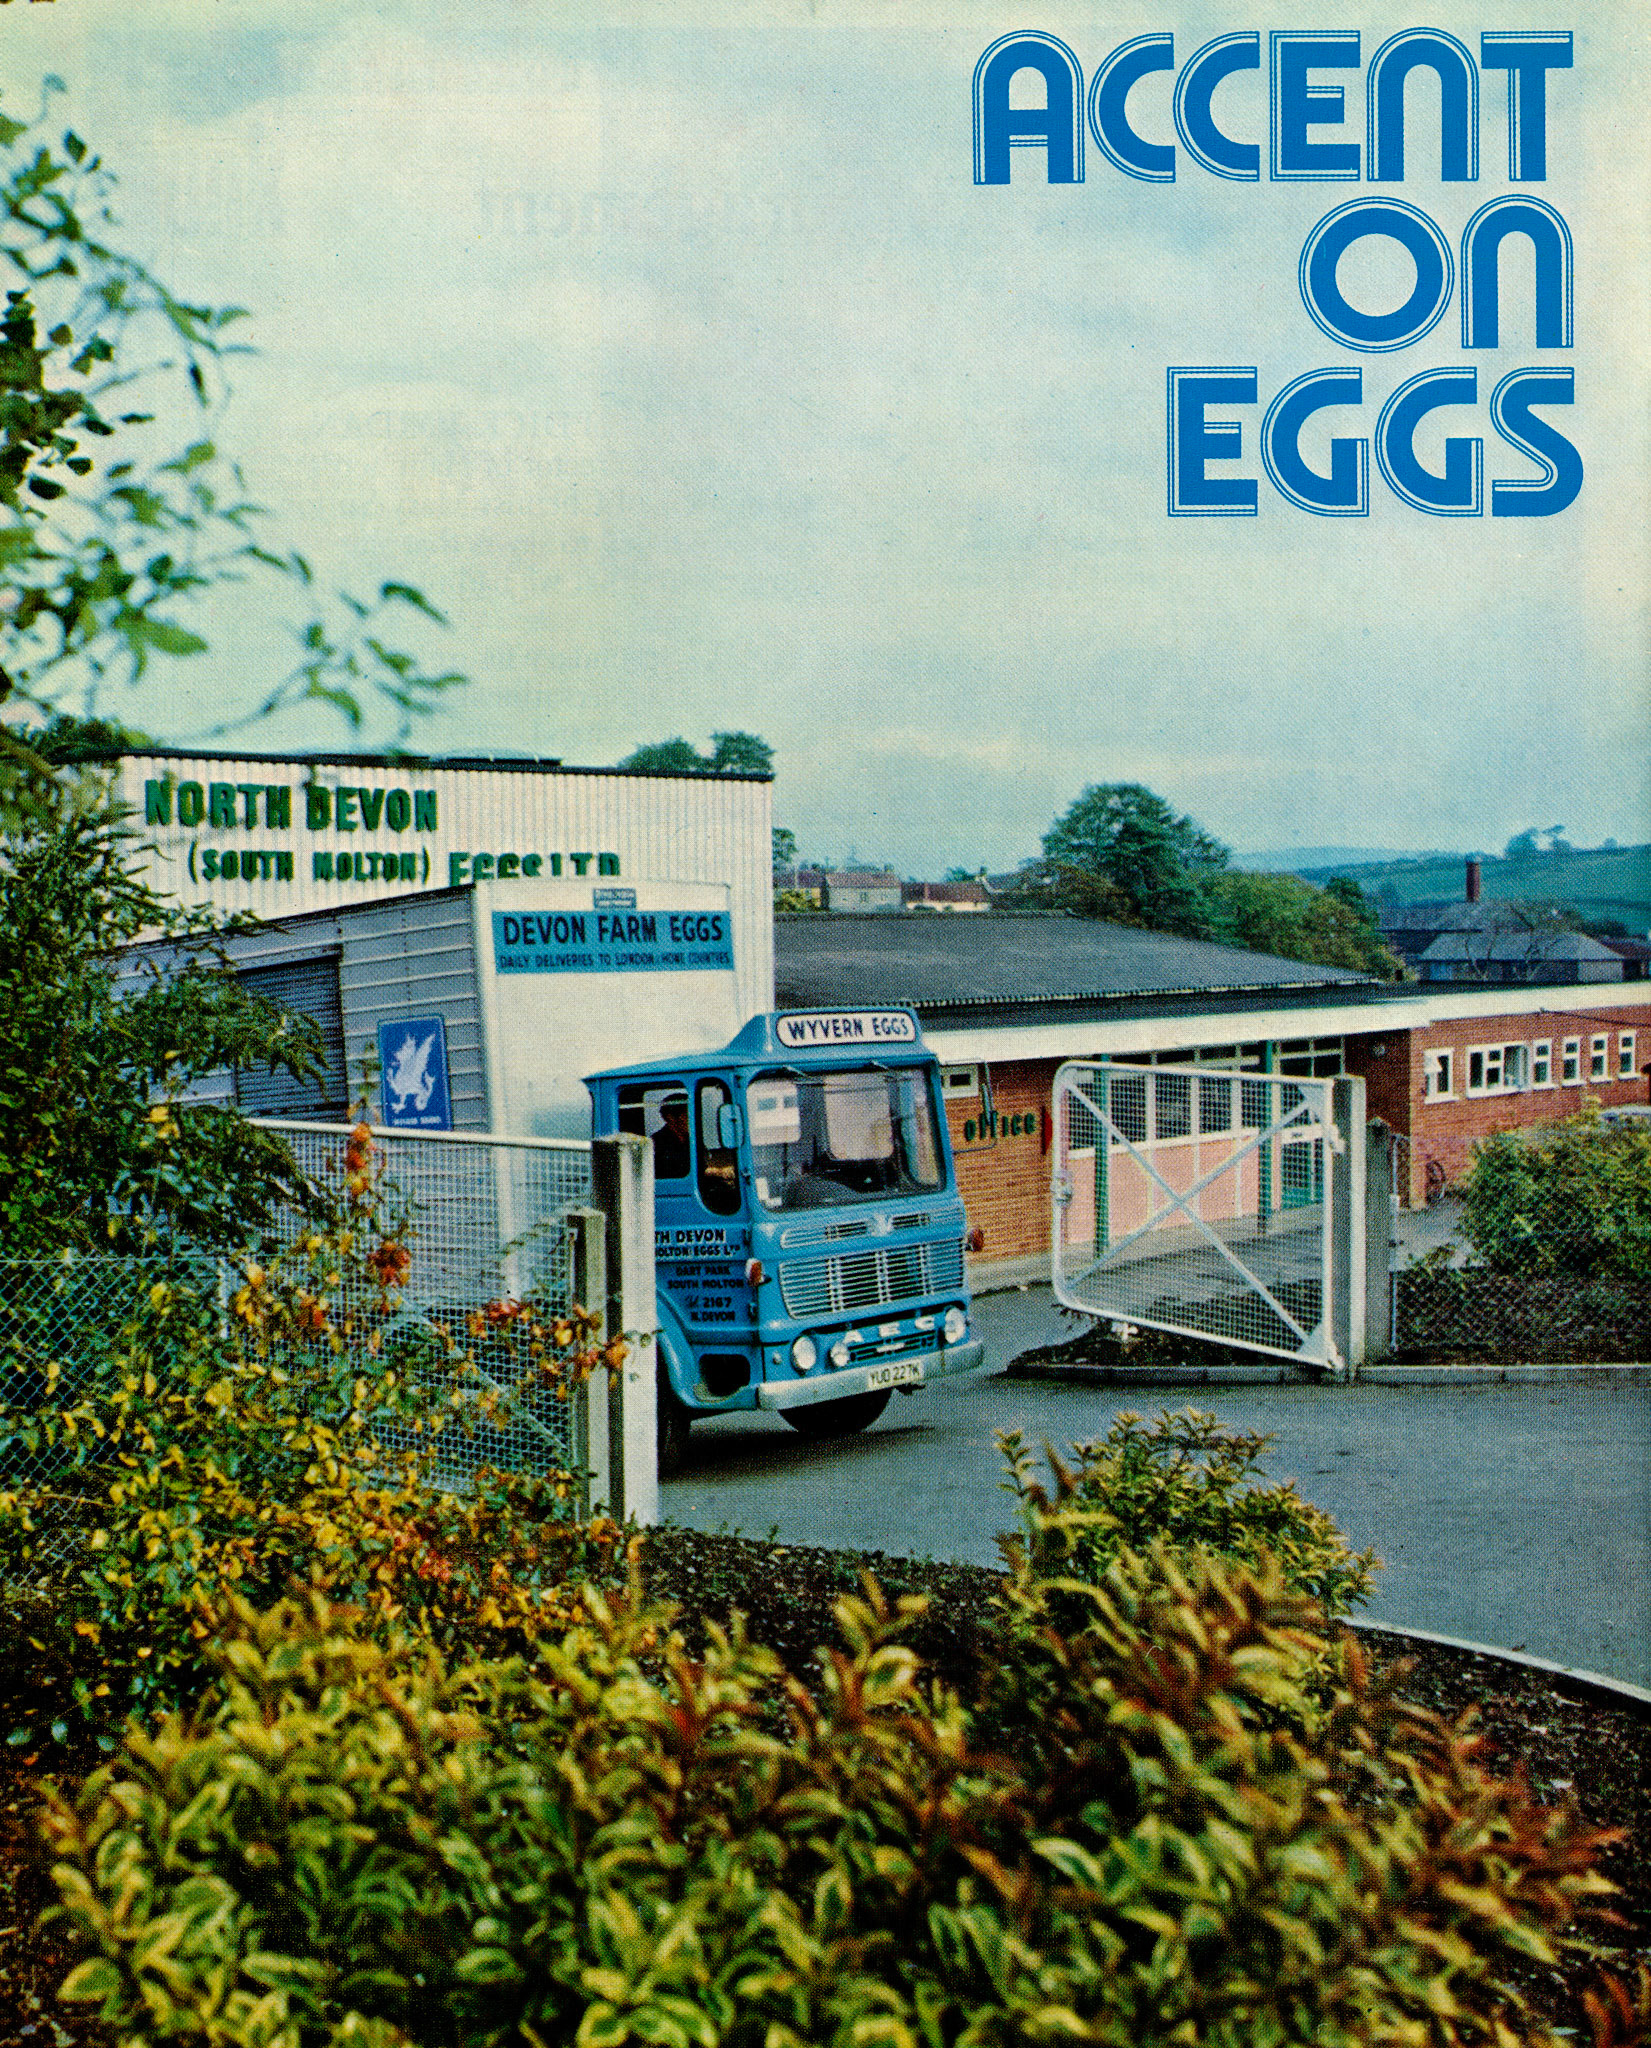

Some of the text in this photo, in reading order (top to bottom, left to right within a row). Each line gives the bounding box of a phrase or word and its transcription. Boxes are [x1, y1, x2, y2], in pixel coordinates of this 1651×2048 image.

[145, 779, 438, 833] NORTH DEVON
[188, 841, 430, 884] (SOUTH MOLTON)
[503, 915, 723, 945] DEVON FARM EGGS
[499, 954, 530, 969] DAILY
[535, 953, 594, 968] DELIVERIES
[598, 952, 612, 966] TO
[787, 1016, 909, 1041] WYVERN EGGS
[675, 1228, 726, 1243] DEVON
[655, 1246, 690, 1257] OLTON
[693, 1244, 721, 1257] EGGS
[667, 1278, 745, 1290] SOUTH MOLTON
[702, 1311, 736, 1323] DEVON
